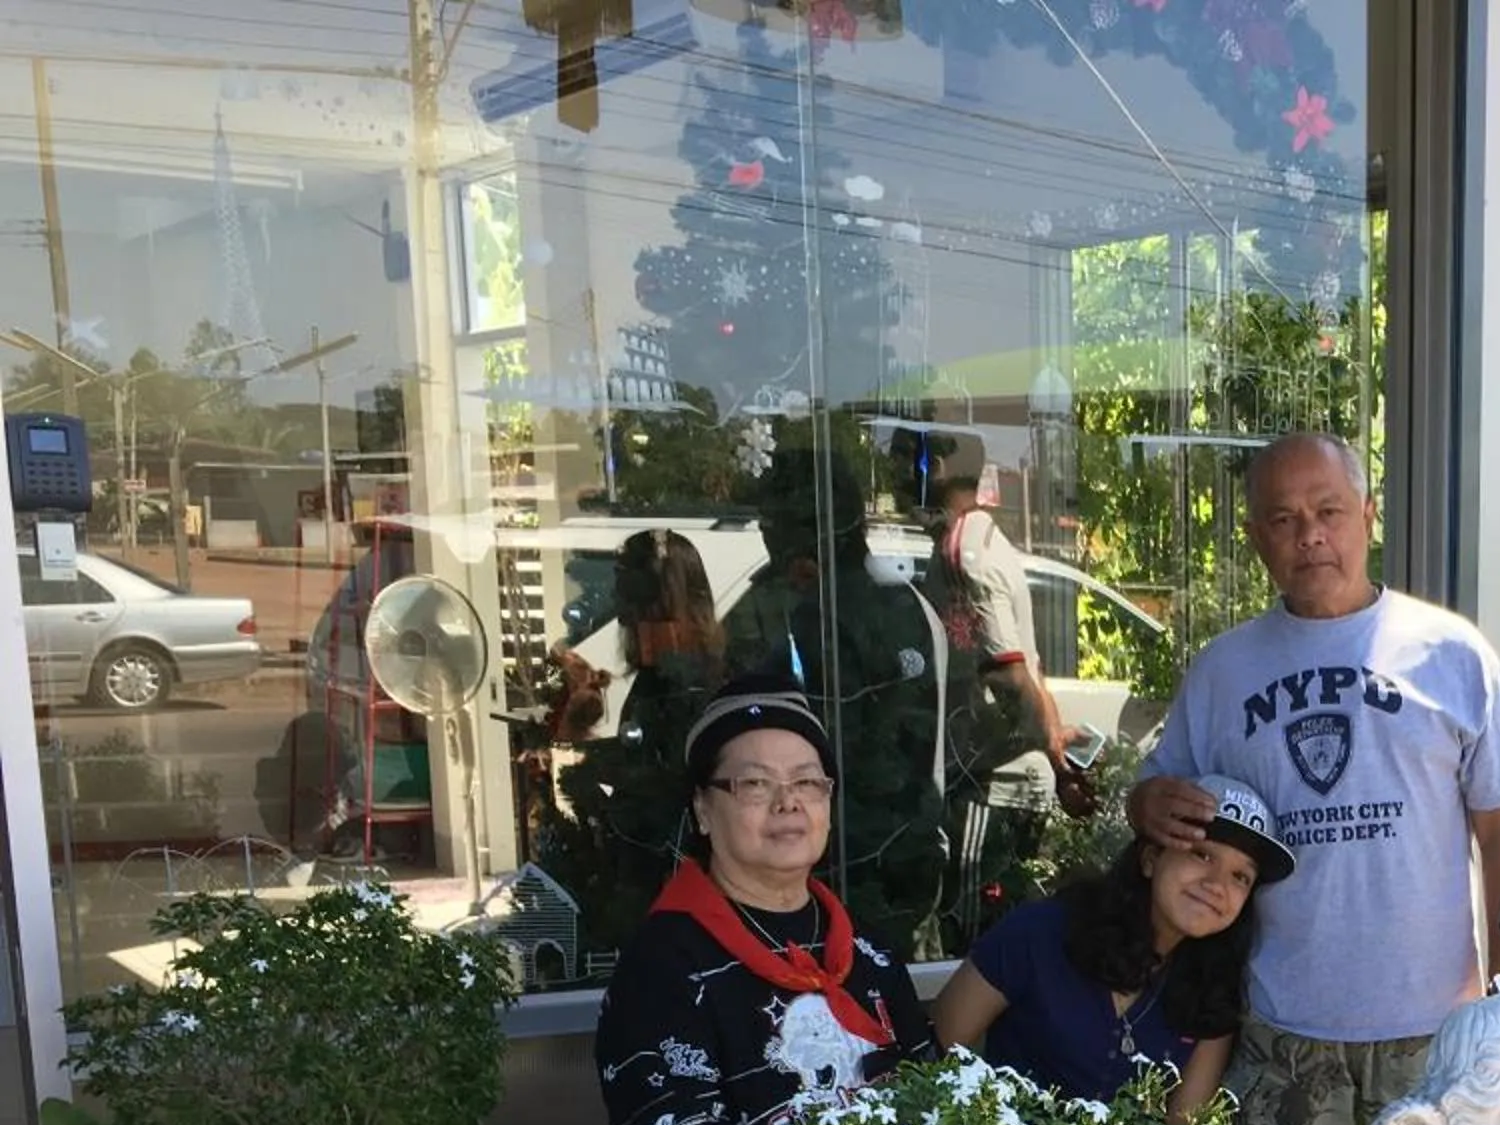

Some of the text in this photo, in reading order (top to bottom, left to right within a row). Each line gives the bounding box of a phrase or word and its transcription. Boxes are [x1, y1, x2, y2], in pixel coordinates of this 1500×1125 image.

[1300, 805, 1355, 825] YORK
[1358, 801, 1403, 819] CITY
[1342, 822, 1396, 842] DEPT.
